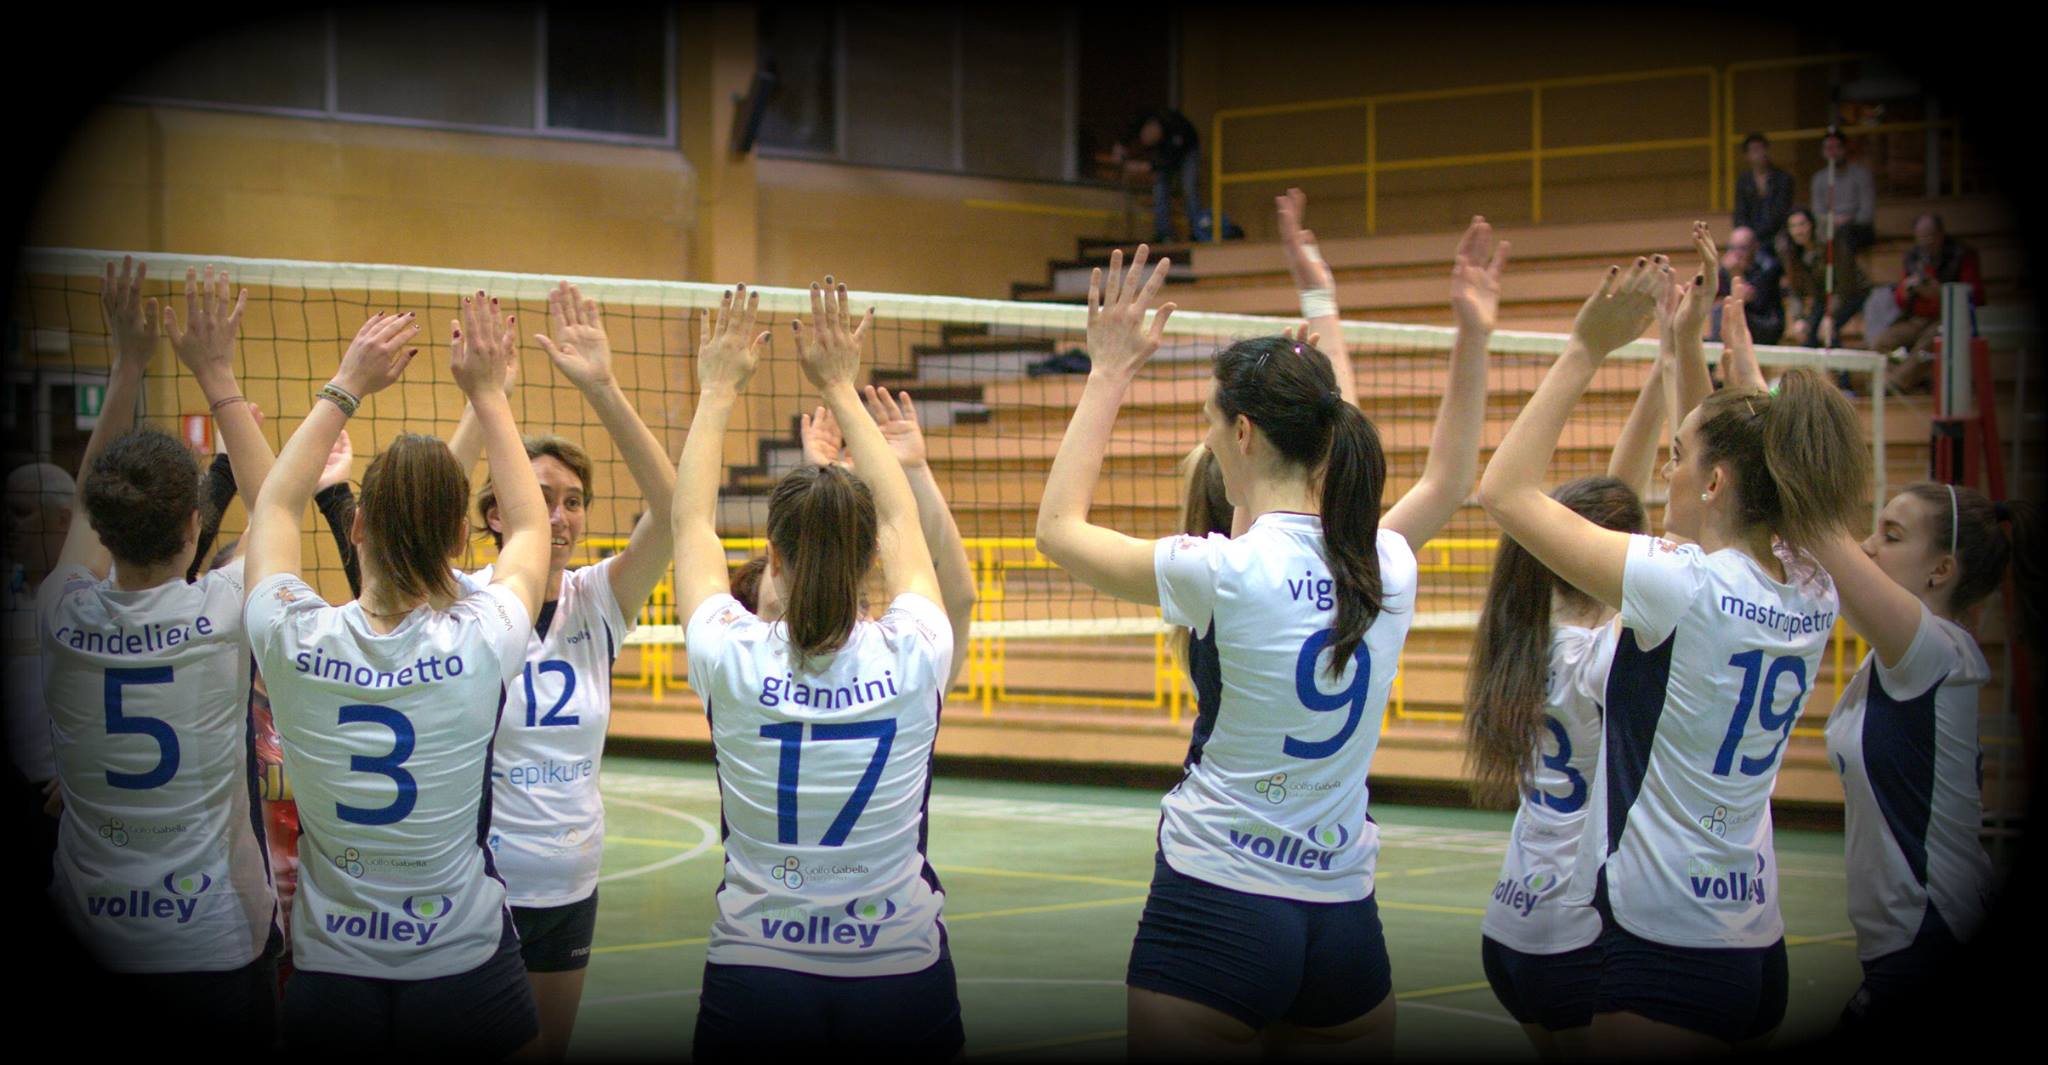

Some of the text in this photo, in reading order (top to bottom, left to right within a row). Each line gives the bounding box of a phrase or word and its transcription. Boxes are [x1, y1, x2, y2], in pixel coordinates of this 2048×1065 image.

[1288, 571, 1334, 611] vig
[295, 648, 463, 689] simonetto
[759, 670, 897, 710] giannini
[523, 659, 580, 728] 12
[1282, 628, 1371, 760] 9
[1712, 649, 1807, 777] 19
[104, 666, 180, 790] 5
[335, 705, 418, 826] 3
[509, 759, 593, 793] epikure
[759, 718, 897, 847] 17
[1530, 713, 1588, 814] 3
[1230, 828, 1335, 871] volley
[88, 889, 198, 924] volley
[326, 911, 438, 946] volley
[761, 914, 881, 949] volley
